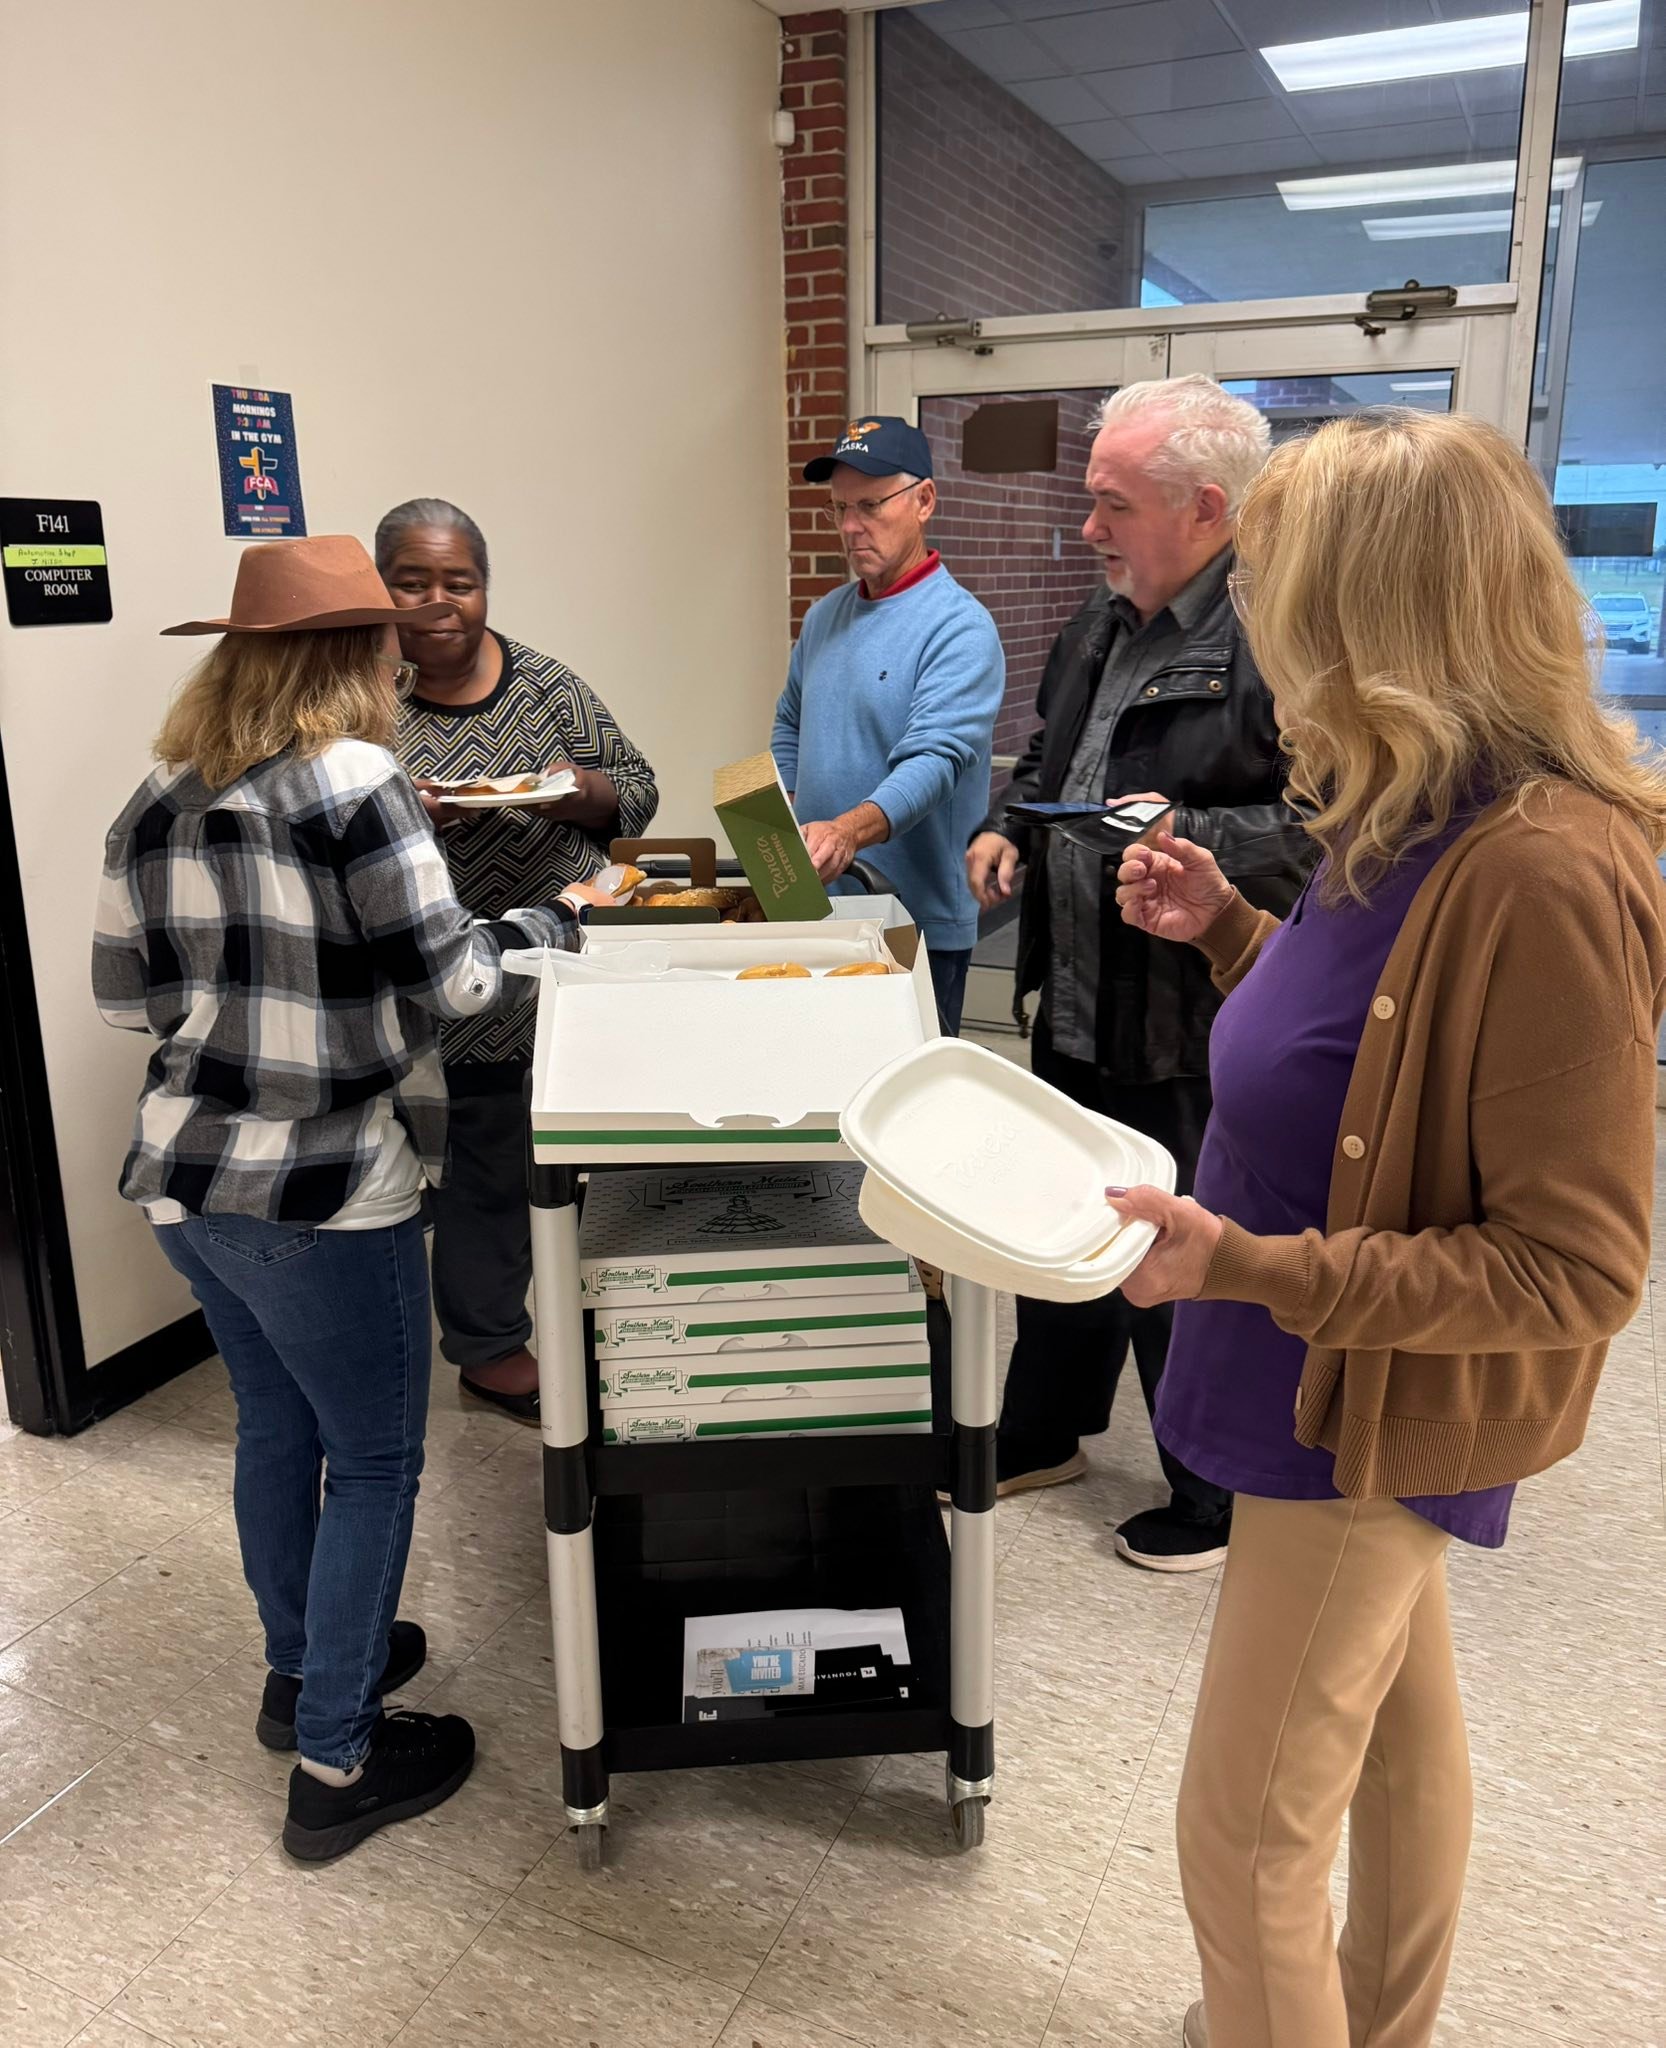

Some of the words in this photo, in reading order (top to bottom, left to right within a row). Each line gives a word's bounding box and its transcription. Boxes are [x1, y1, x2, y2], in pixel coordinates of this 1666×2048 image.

[231, 389, 273, 402] THUSDA
[232, 403, 276, 417] MORNINGS
[256, 418, 271, 429] AM
[231, 431, 241, 441] IN
[242, 432, 259, 443] THE
[261, 433, 282, 444] GYM
[250, 477, 272, 489] FCA
[36, 514, 70, 533] F141
[25, 569, 93, 581] COMPUTER
[44, 584, 79, 596] ROOM
[770, 833, 798, 883] CATERING
[757, 835, 790, 898] Panera
[665, 1178, 743, 1190] Southern
[599, 1269, 629, 1278] Southern
[618, 1320, 648, 1329] Southern
[651, 1319, 671, 1327] Maid
[620, 1371, 650, 1379] Southern
[630, 1419, 659, 1427] Southern
[752, 1655, 780, 1667] YOU'RE
[751, 1667, 781, 1680] INVITED
